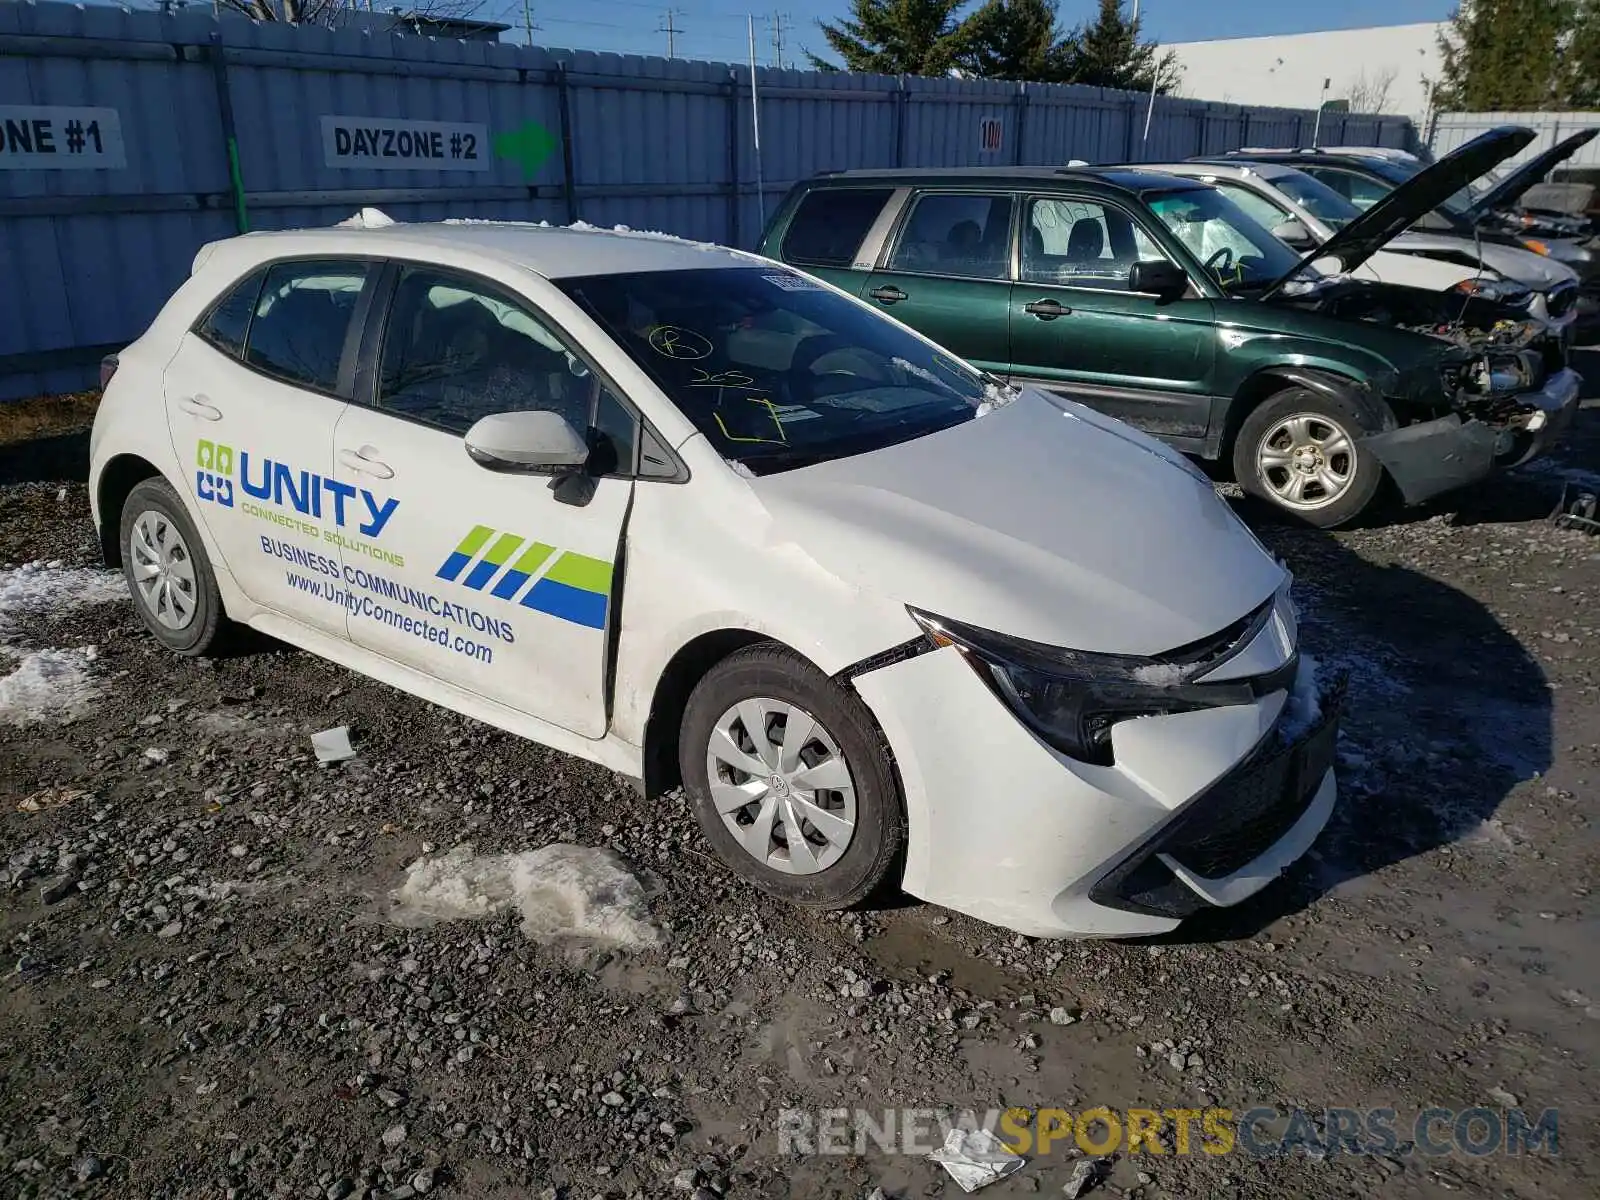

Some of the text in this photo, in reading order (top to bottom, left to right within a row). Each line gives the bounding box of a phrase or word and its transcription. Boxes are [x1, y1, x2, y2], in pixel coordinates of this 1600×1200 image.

[0, 119, 103, 153] NE #1
[334, 127, 478, 160] DAYZONE #2
[240, 451, 401, 538] UNITY
[241, 502, 405, 568] CONNECTED SOLUTIONS
[260, 535, 516, 644] BUSINESS COMMUNICATIONS
[286, 571, 493, 664] www.UnityConnected.com
